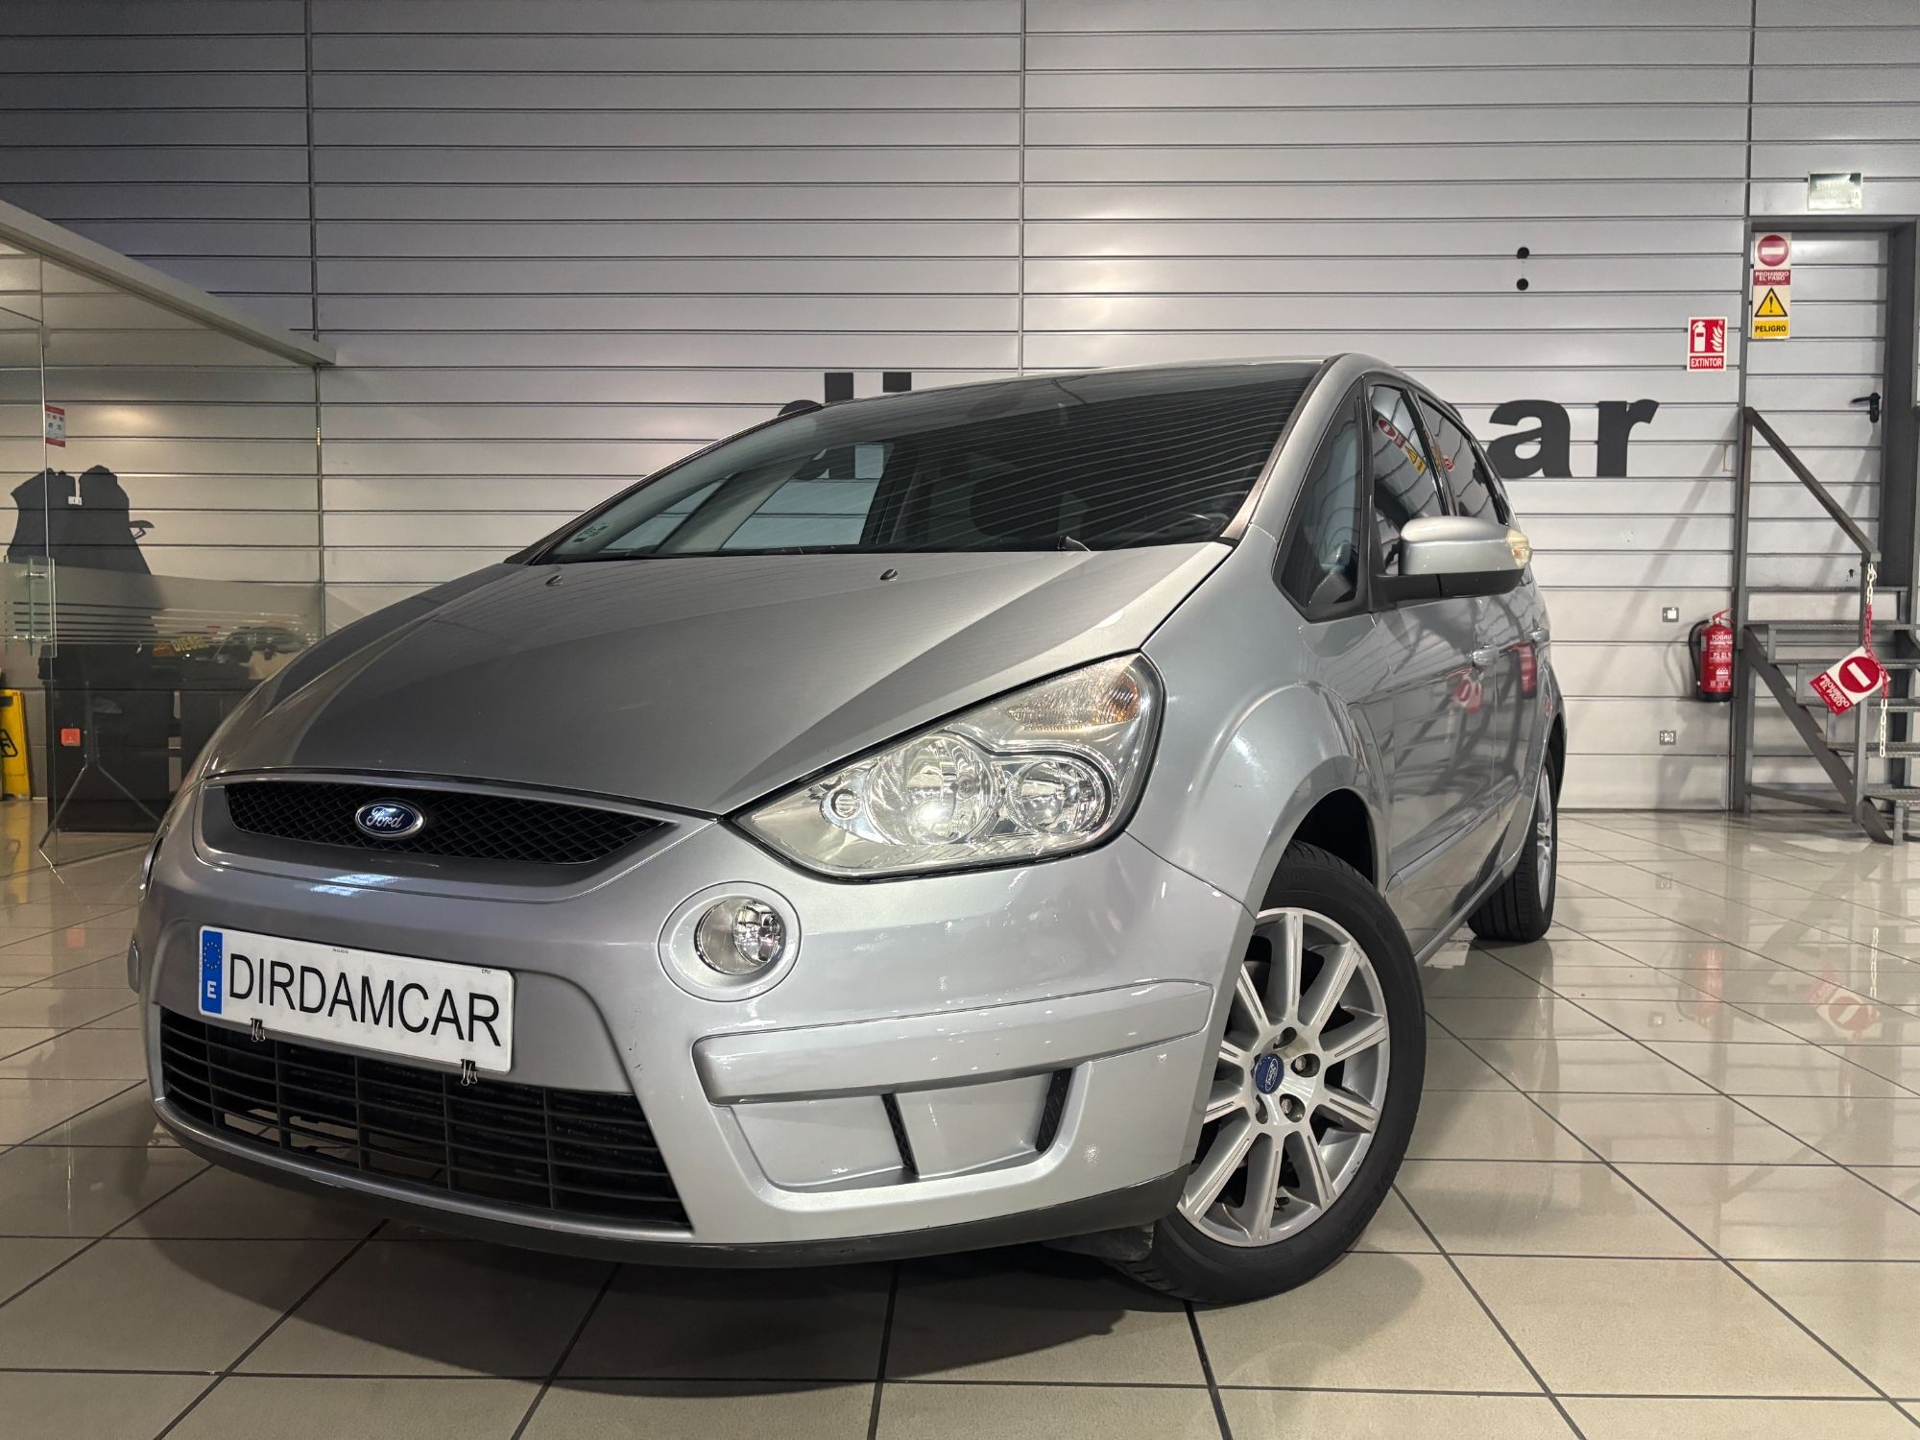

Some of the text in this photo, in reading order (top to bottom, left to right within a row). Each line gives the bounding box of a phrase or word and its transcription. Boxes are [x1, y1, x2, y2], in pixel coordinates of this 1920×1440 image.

[1691, 358, 1722, 367] EXTINTOR
[1450, 399, 1660, 478] ar
[1821, 674, 1850, 708] PROHIBIDO
[1826, 689, 1843, 707] PASO
[366, 805, 405, 829] Ford
[206, 980, 217, 999] E
[229, 953, 501, 1047] DIRDAMCAR
